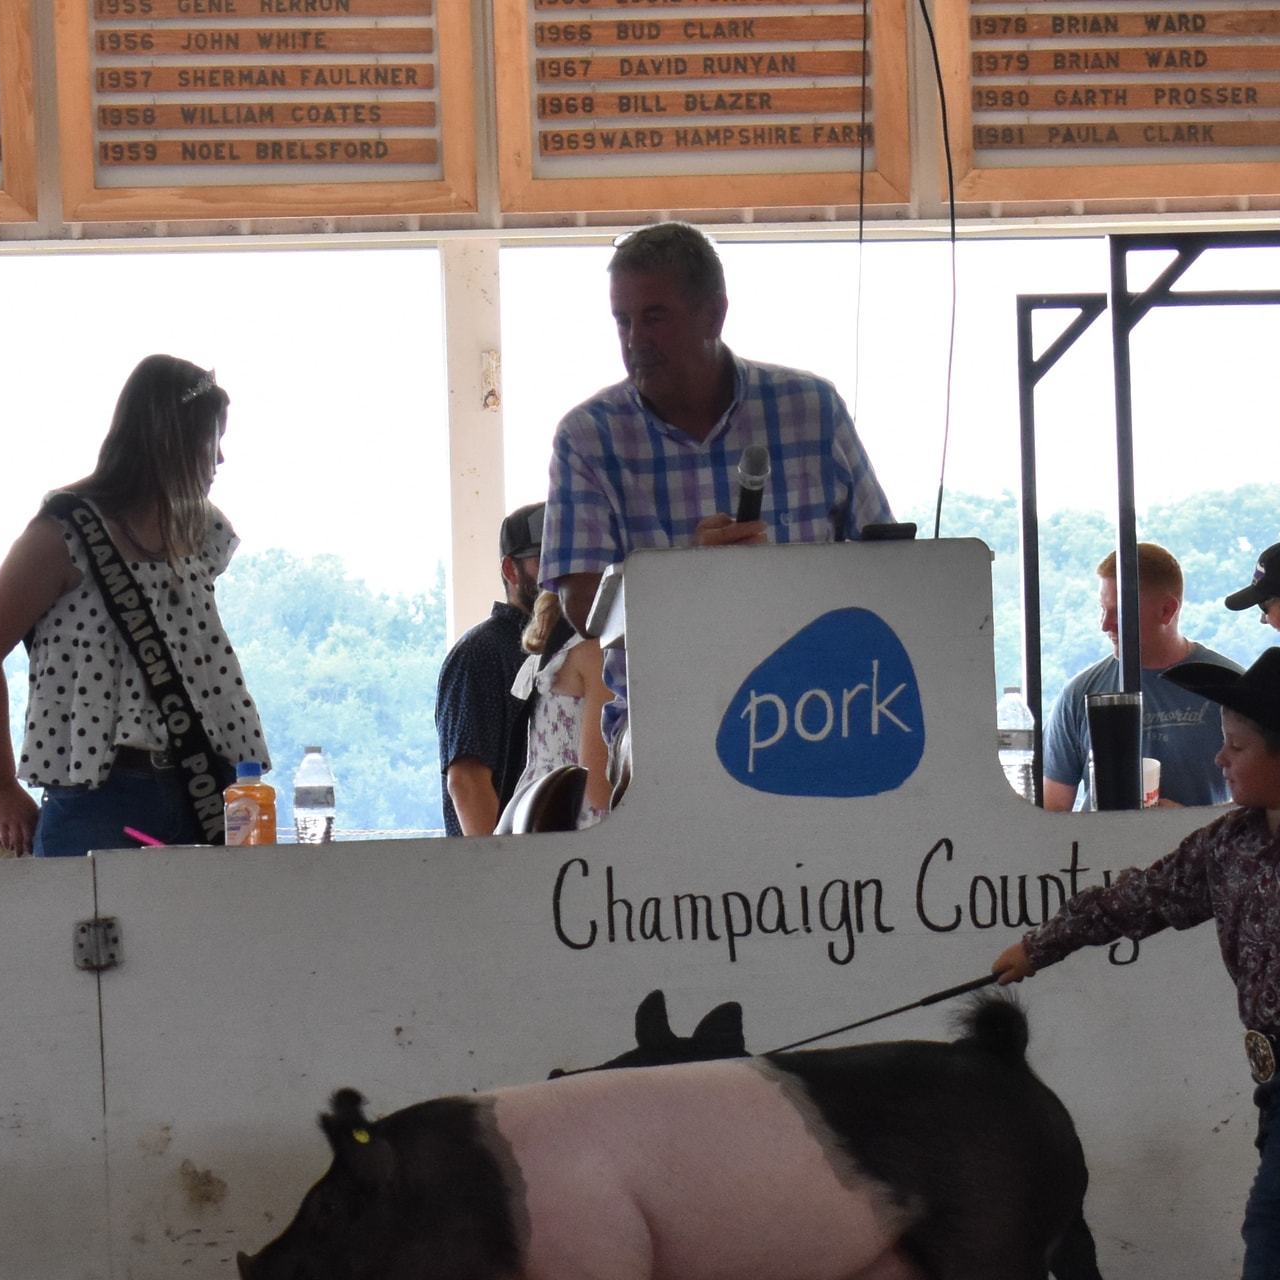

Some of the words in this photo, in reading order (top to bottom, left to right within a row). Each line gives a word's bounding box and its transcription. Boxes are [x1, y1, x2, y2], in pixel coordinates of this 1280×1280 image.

[97, 0, 153, 13] 1955
[178, 0, 237, 13] GENE
[261, 0, 351, 12] HERRON
[537, 24, 593, 42] 1966
[617, 22, 661, 40] BUD
[684, 20, 755, 38] CLARK
[975, 18, 1027, 35] 1978
[1052, 15, 1118, 34] BRIAN
[1144, 13, 1206, 32] WARD
[99, 33, 154, 51] 1956
[181, 31, 240, 50] JOHN
[257, 31, 327, 49] WHITE
[540, 60, 592, 77] 1967
[620, 58, 687, 76] DAVID
[704, 55, 796, 74] RUNYAN
[977, 53, 1029, 71] 1979
[1054, 51, 1119, 70] BRIAN
[1146, 50, 1207, 67] WARD
[99, 70, 153, 89] 1957
[178, 69, 285, 86] SHERMAN
[301, 67, 418, 85] FAULKNER
[542, 97, 594, 114] 1968
[619, 95, 667, 112] BILL
[685, 92, 772, 111] BLAZER
[977, 90, 1029, 107] 1980
[1054, 88, 1127, 106] GARTH
[1154, 86, 1258, 104] PROSSER
[101, 107, 156, 125] 1958
[181, 106, 274, 124] WILLIAM
[292, 105, 381, 123] COATES
[543, 132, 597, 151] 1969
[600, 130, 663, 149] WARD
[676, 127, 802, 145] HAMPSHIRE
[977, 127, 1024, 144] 1981
[1049, 126, 1119, 143] PAULA
[1143, 124, 1215, 142] CLARK
[103, 144, 157, 161] 1959
[181, 143, 240, 161] NOEL
[257, 141, 388, 160] BRELSFORD
[72, 506, 172, 687] CHAMPAIGN
[161, 693, 191, 747] CO.
[181, 752, 225, 842] PORK
[741, 660, 913, 773] pork
[552, 857, 895, 966] Champaign
